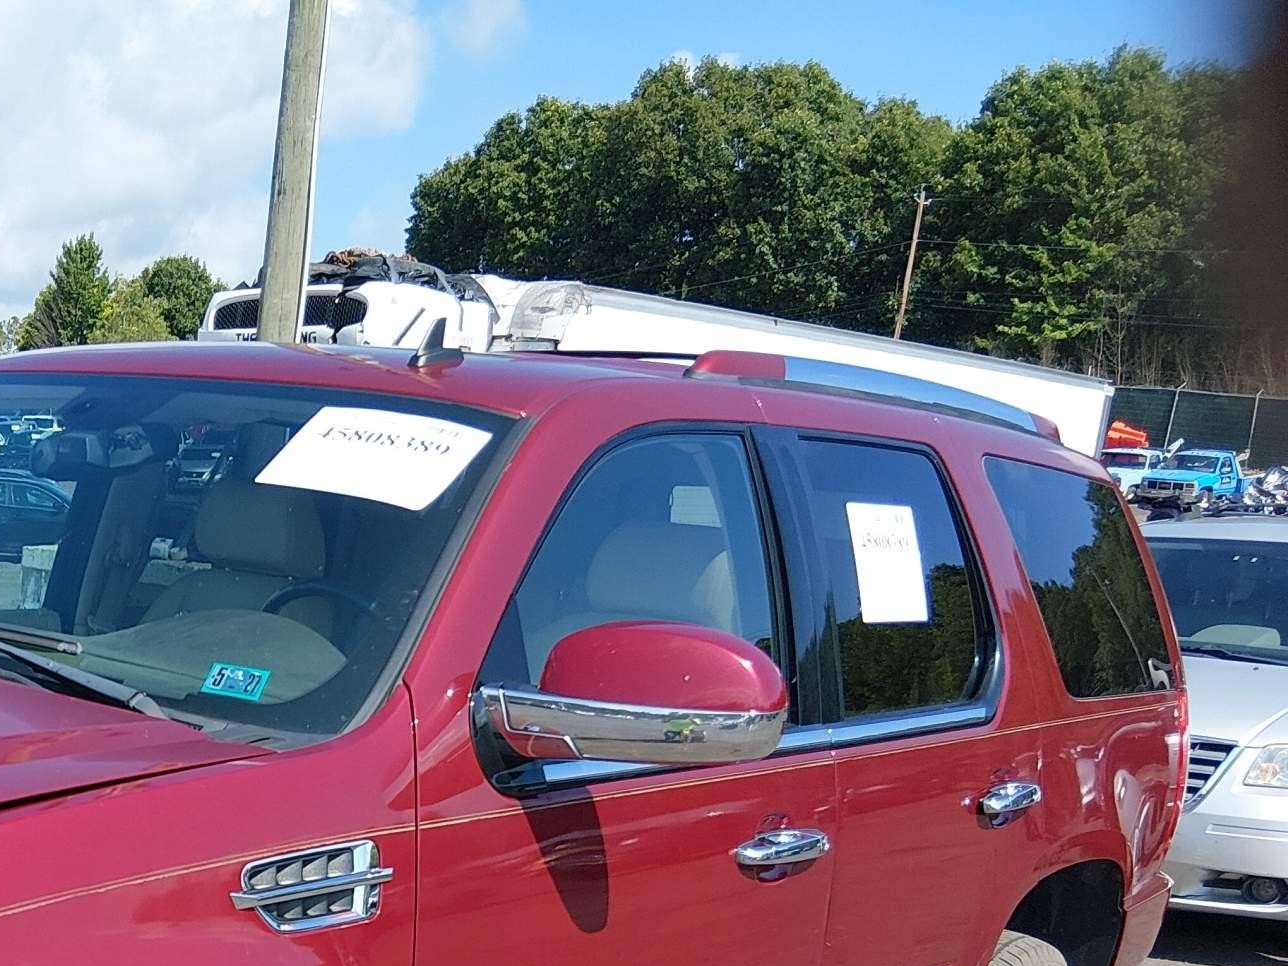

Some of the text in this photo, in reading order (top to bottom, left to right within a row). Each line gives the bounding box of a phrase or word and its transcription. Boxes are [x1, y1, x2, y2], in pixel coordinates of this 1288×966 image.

[300, 331, 317, 343] NG
[212, 667, 263, 695] 5 27
